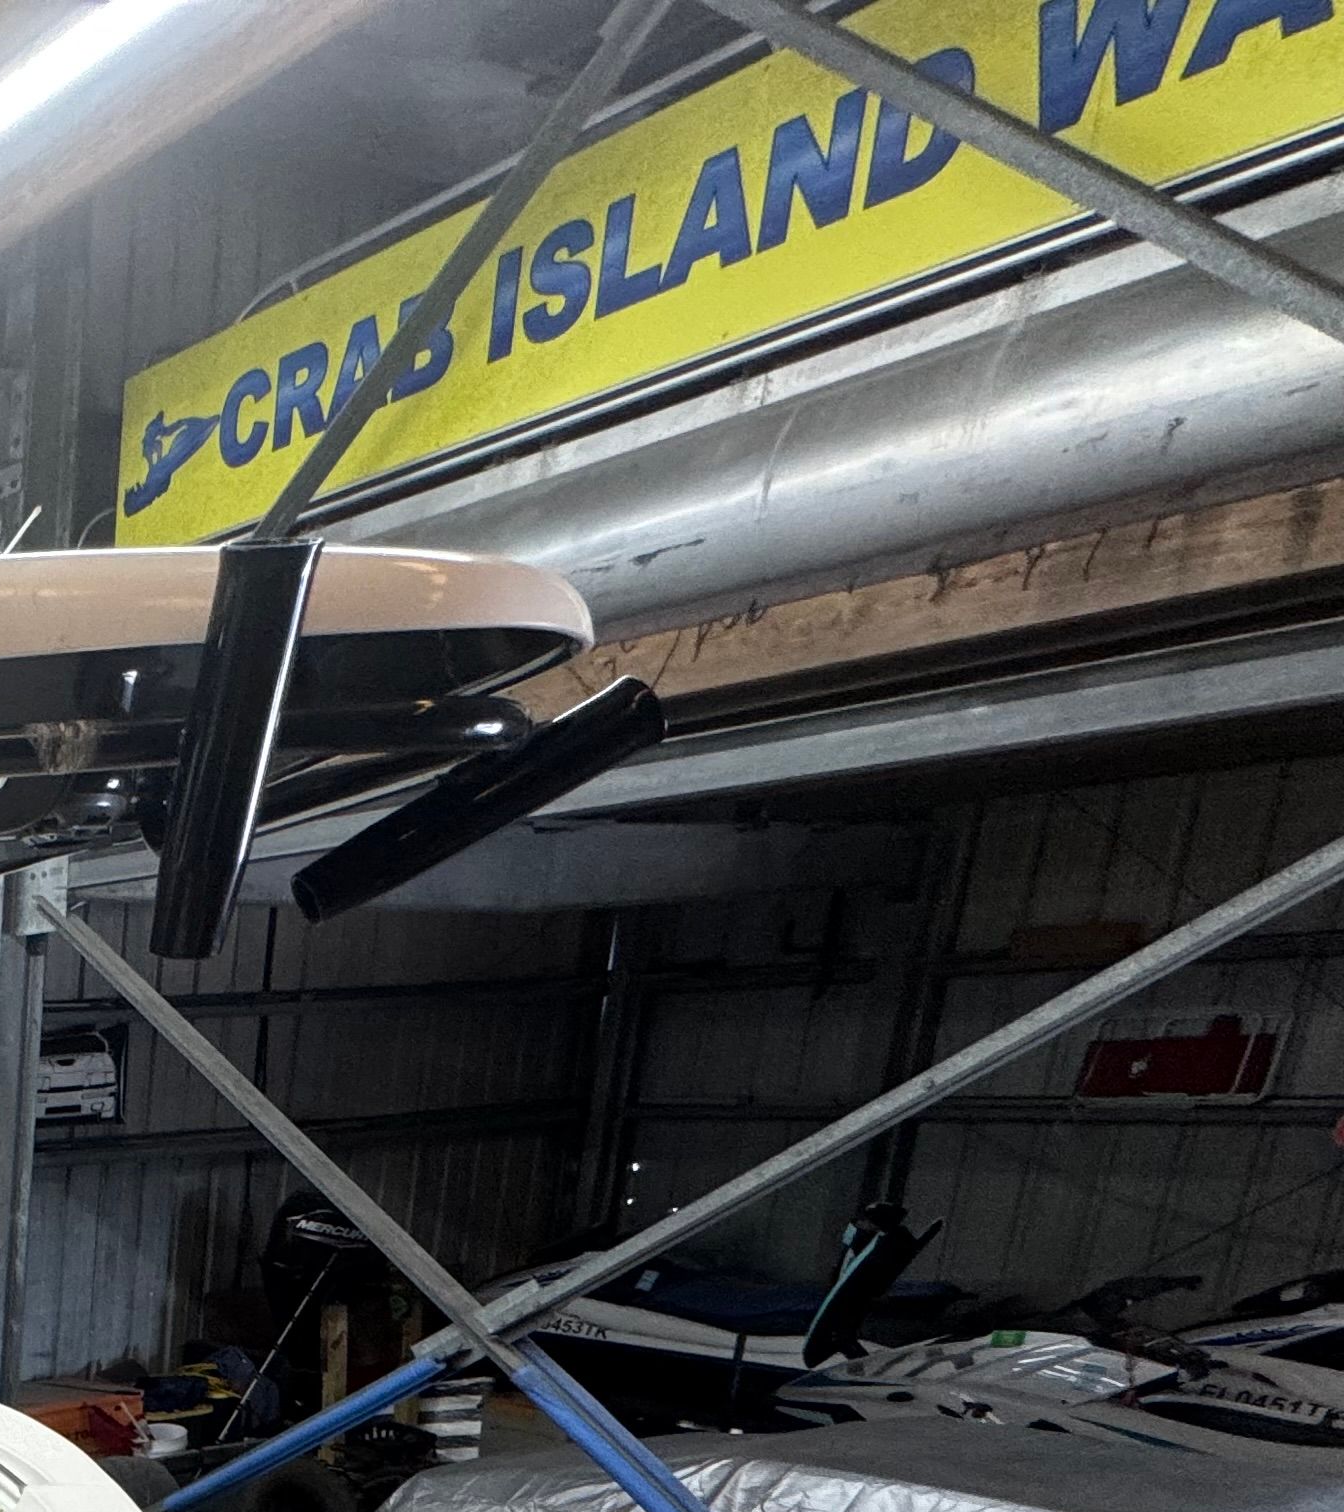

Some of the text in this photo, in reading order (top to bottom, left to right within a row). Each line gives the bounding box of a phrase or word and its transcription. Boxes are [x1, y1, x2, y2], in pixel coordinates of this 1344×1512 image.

[219, 291, 454, 469] CRAB
[487, 47, 976, 366] ISLAND
[295, 1219, 368, 1241] MERCUR
